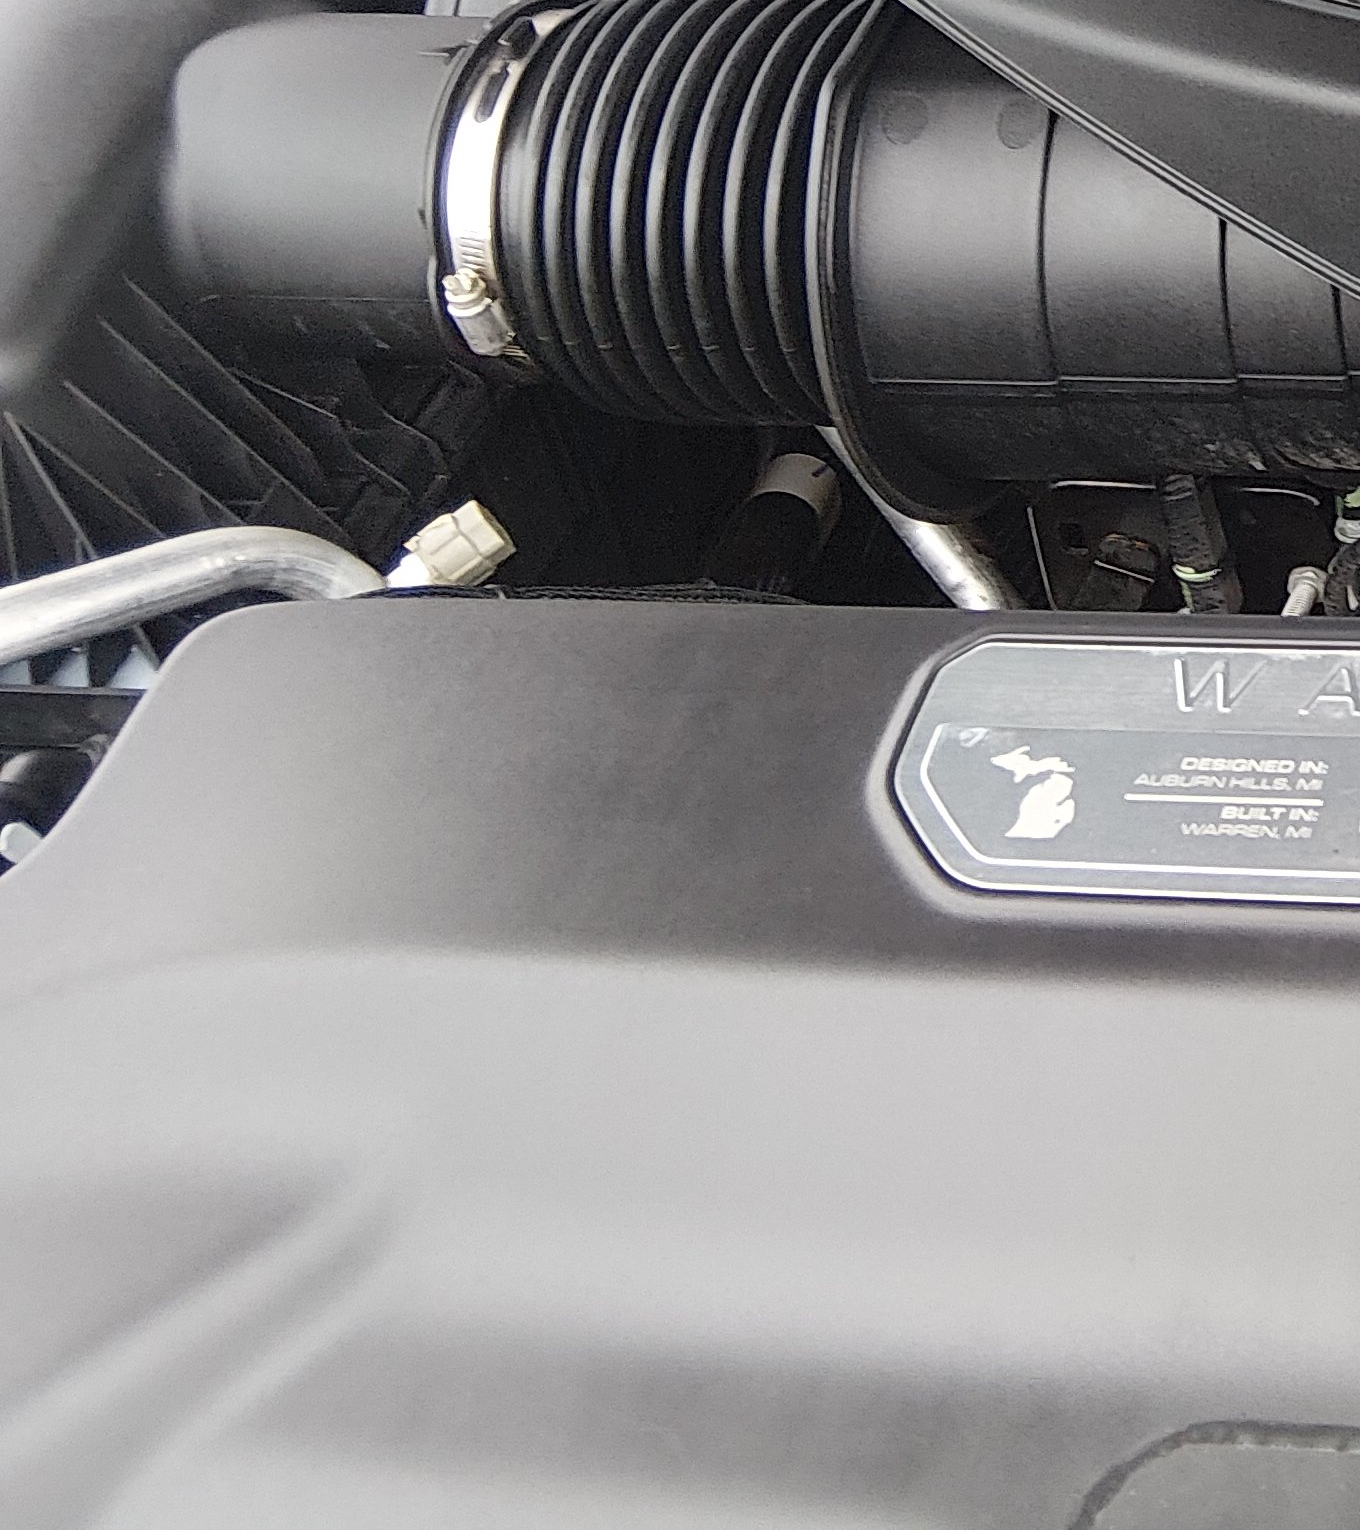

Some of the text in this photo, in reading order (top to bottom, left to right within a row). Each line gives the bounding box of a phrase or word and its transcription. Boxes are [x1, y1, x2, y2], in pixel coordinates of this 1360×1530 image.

[1180, 756, 1329, 775] DESIGNED IN:
[1133, 773, 1227, 789] AUBURN
[1296, 777, 1324, 791] MI
[1220, 805, 1320, 822] BUILT IN:
[1181, 822, 1313, 840] WARREN, MI
